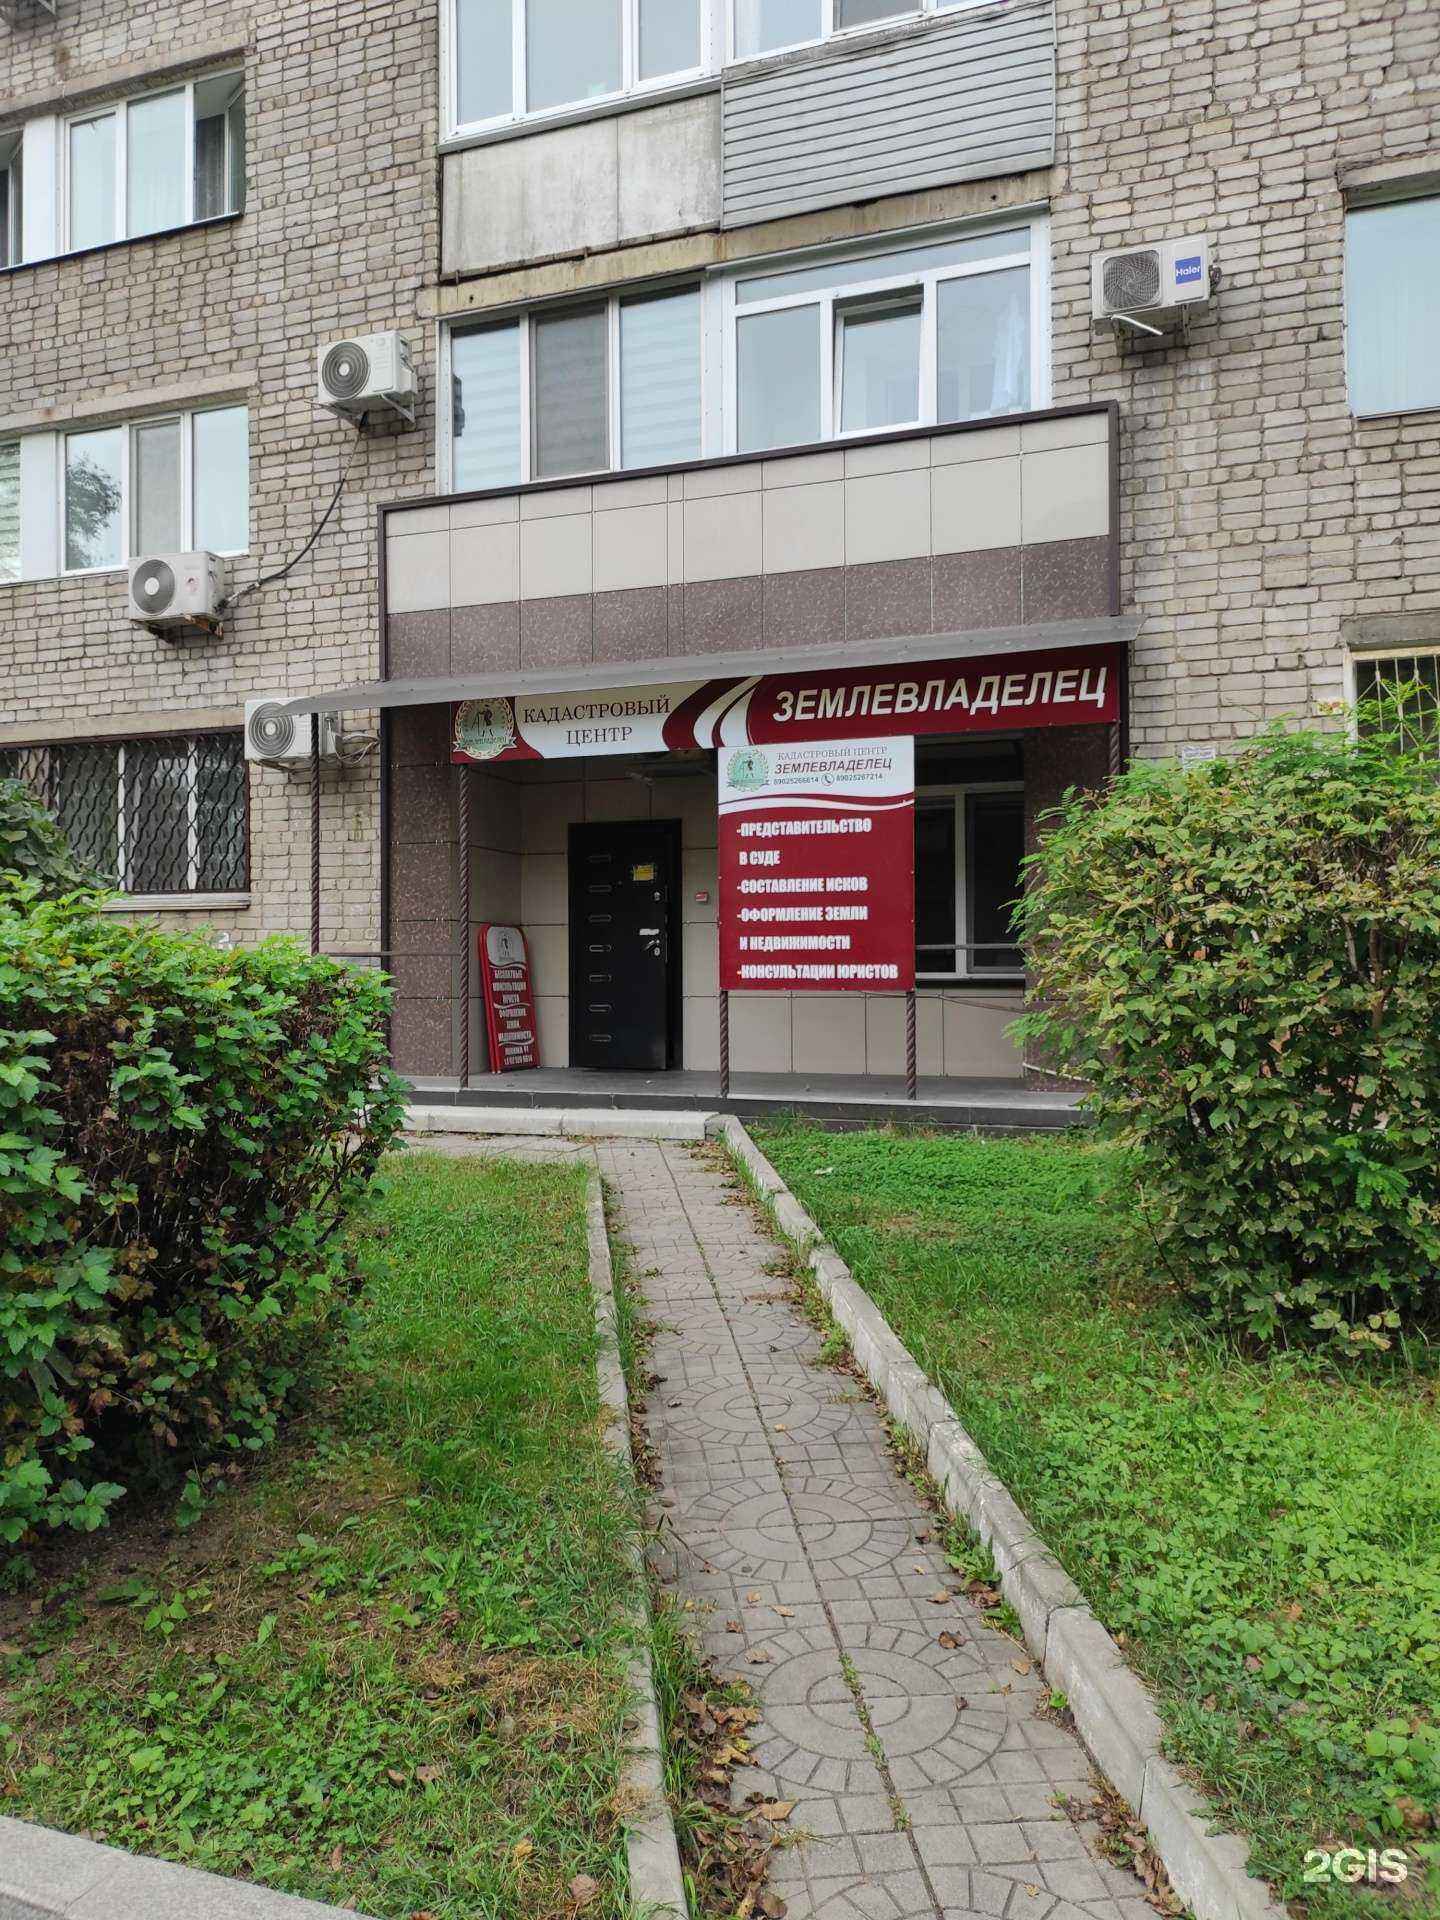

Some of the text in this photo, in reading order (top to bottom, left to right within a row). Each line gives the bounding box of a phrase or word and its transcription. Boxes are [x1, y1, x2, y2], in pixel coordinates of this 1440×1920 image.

[1176, 265, 1201, 277] Haier
[772, 667, 1107, 722] ЗЕМЛЕВЛАДЕЛЕЦ
[523, 694, 671, 724] КАДАСТРОВЫЙ
[566, 726, 633, 747] ЦЕНТР
[777, 747, 887, 761] КАДАСТРОВЫЙ ЦЕНТР
[774, 758, 892, 775] ЗЕМЛЕВЛАДЕЛЕЦ
[739, 850, 781, 866] В СУДЕ
[826, 876, 868, 892] ИСКОВ
[825, 906, 868, 921] ЗЕМЛИ
[739, 935, 850, 952] И НЕДВИЖИМОСТИ
[837, 964, 899, 979] ЮРИСТОВ
